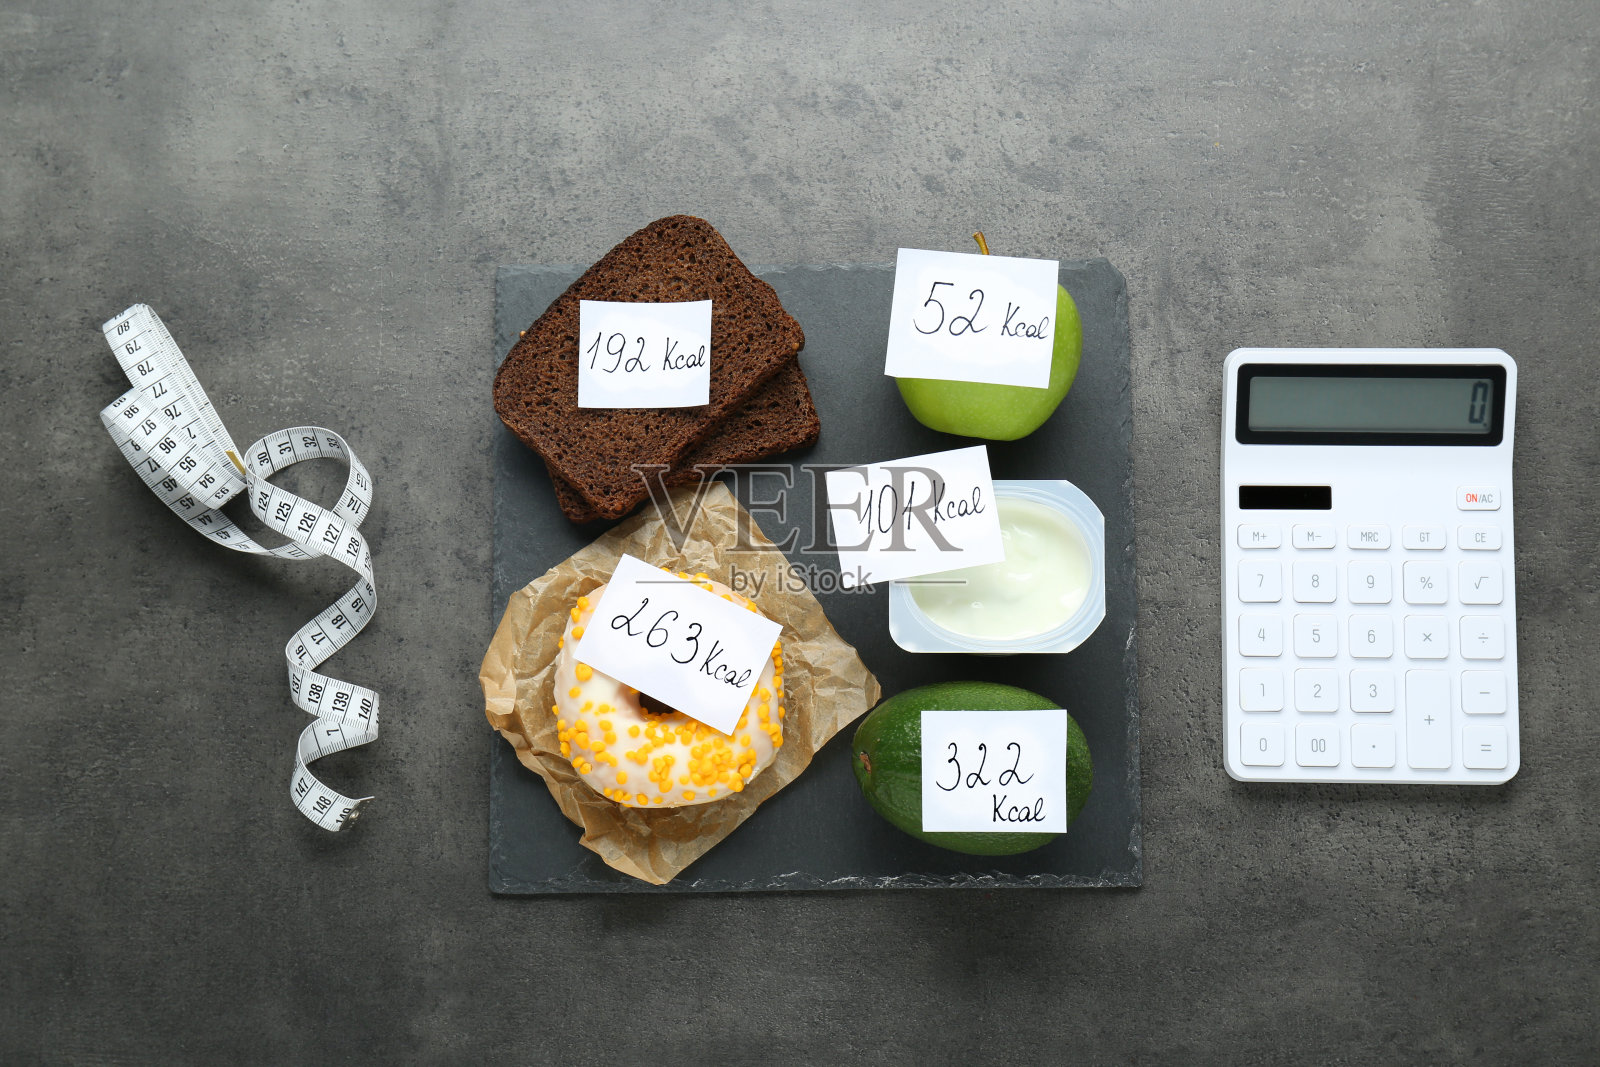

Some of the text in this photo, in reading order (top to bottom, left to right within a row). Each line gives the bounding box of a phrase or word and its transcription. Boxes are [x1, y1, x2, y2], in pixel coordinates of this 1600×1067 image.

[913, 281, 1049, 339] 52 Kcal
[117, 321, 130, 335] 80
[125, 339, 142, 355] 79
[587, 332, 705, 373] 192 Kcal
[137, 360, 155, 376] 78
[152, 383, 168, 399] 77
[124, 405, 140, 419] 98
[164, 404, 182, 421] 76
[141, 419, 157, 436] 97
[187, 427, 197, 440] 7
[131, 441, 142, 452] 8
[159, 437, 177, 454] 96
[278, 441, 292, 454] 31
[303, 436, 317, 448] 32
[179, 456, 197, 473] 95
[257, 451, 269, 466] 30
[162, 478, 178, 492] 46
[199, 473, 215, 489] 94
[214, 486, 230, 500] 93
[1465, 493, 1493, 504] ON/AC
[180, 497, 195, 510] 45
[258, 491, 269, 511] 124
[347, 496, 361, 514] 114
[933, 479, 985, 525] Kcal
[275, 501, 291, 522] 125
[199, 514, 213, 526] 44
[298, 512, 316, 533] 126
[216, 530, 231, 540] 43
[323, 523, 340, 544] 127
[1252, 532, 1268, 542] M+
[1307, 532, 1322, 542] M-
[1360, 532, 1379, 542] MRC
[1419, 532, 1431, 542] GT
[1475, 532, 1487, 543] CE
[347, 537, 360, 557] 128
[1257, 574, 1264, 588] 7
[1311, 574, 1320, 588] 8
[1366, 575, 1375, 589] 9
[1420, 576, 1433, 589] %
[351, 598, 364, 613] 19
[331, 614, 346, 629] 18
[311, 632, 326, 645] 17
[1257, 628, 1265, 642] 4
[1312, 629, 1320, 643] 5
[1367, 629, 1376, 643] 6
[611, 597, 752, 688] 263 Kcal
[295, 645, 307, 660] 16
[292, 674, 301, 694] 137
[1260, 683, 1265, 697] 1
[1313, 684, 1322, 698] 2
[1369, 684, 1377, 698] 3
[308, 683, 323, 704] 138
[332, 692, 349, 712] 139
[358, 698, 372, 720] 140
[1259, 737, 1267, 751] 0
[1311, 738, 1326, 752] 00
[936, 742, 1034, 791] 322
[295, 777, 309, 797] 147
[313, 796, 332, 815] 148
[993, 794, 1046, 822] Kcal
